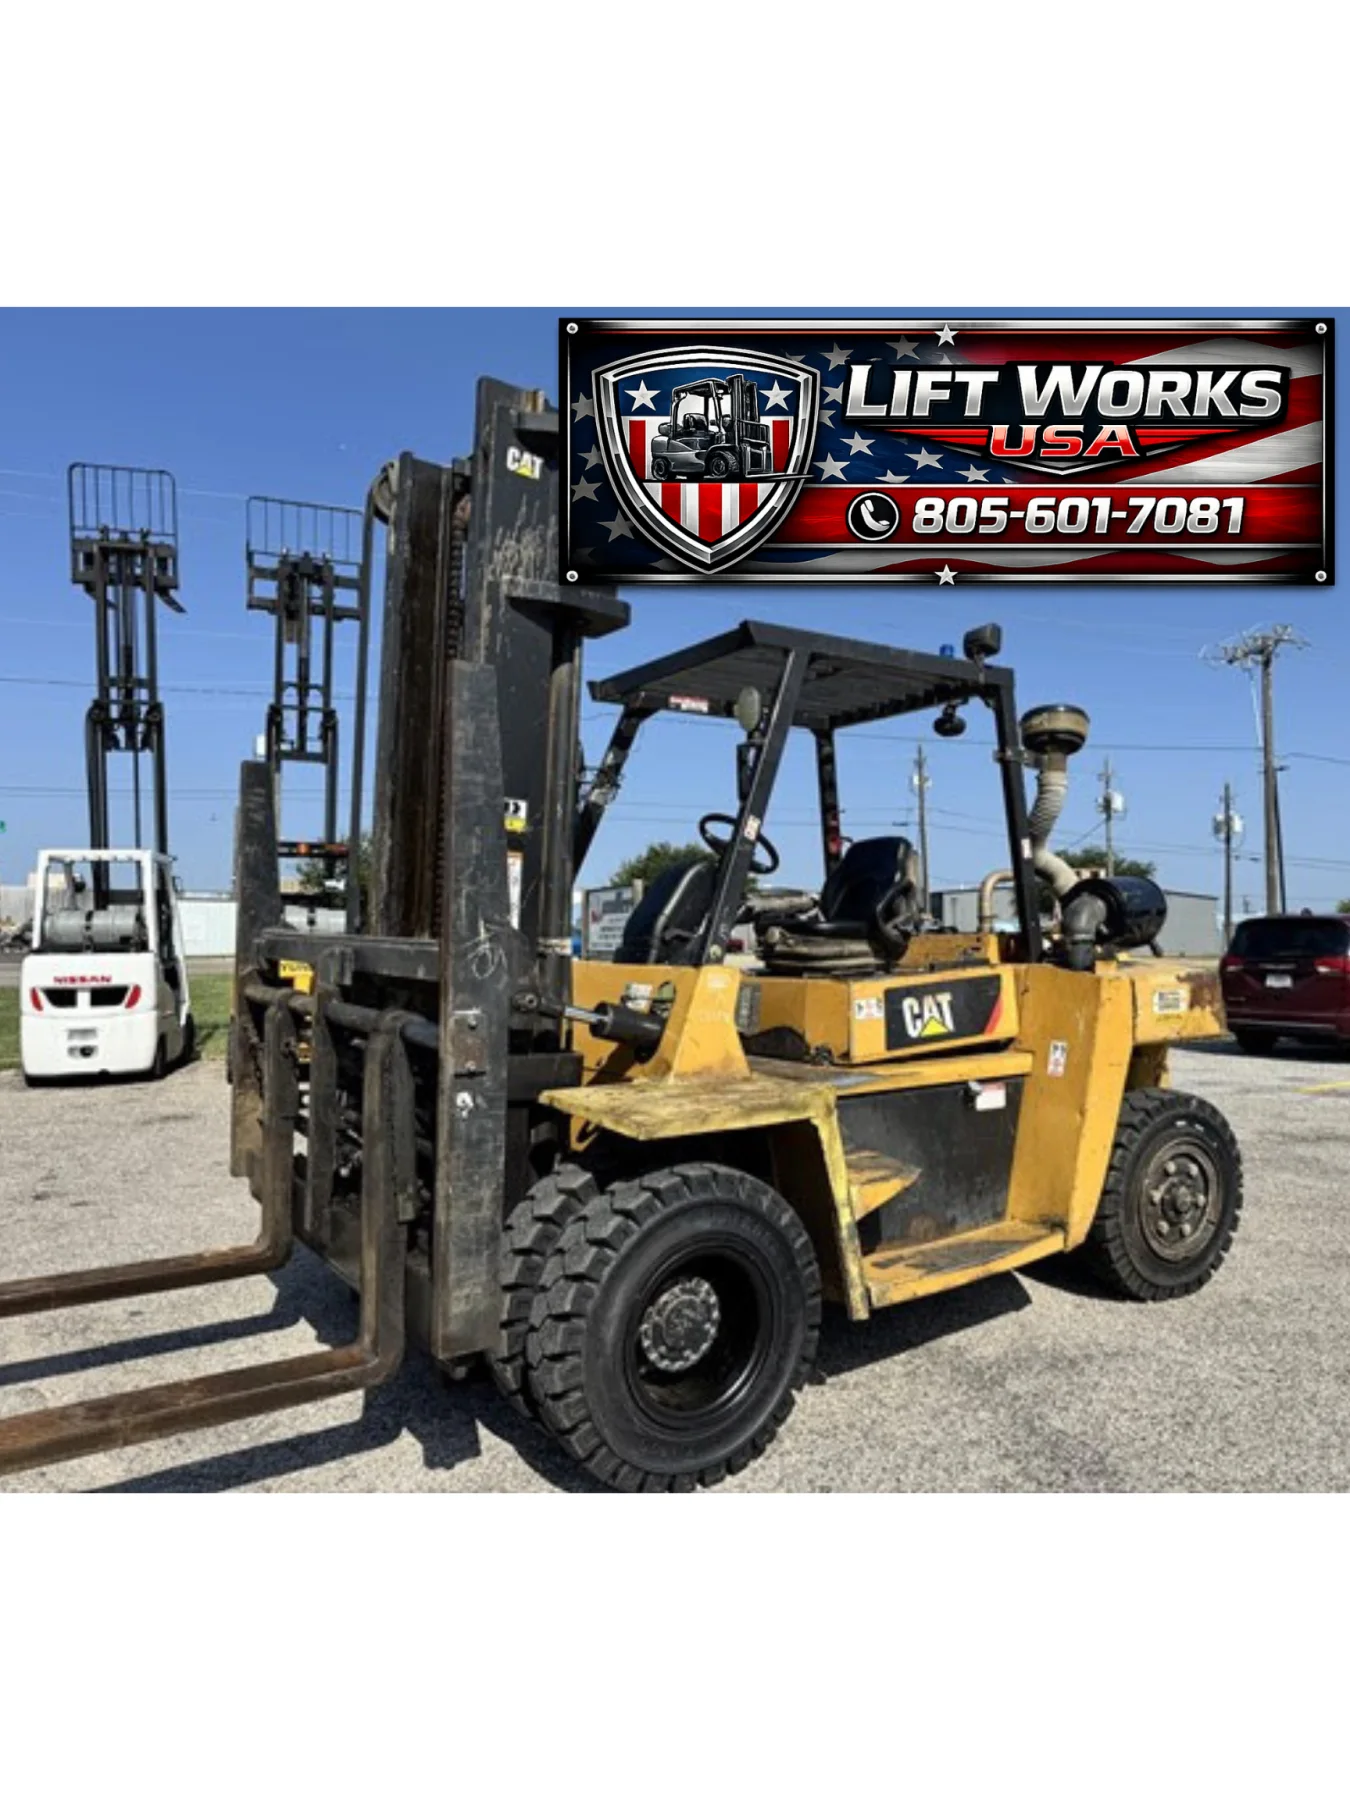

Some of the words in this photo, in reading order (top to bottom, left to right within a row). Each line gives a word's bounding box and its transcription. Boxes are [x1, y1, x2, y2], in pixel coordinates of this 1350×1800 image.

[506, 446, 545, 481] CAT
[53, 974, 113, 984] NISSAN
[902, 991, 955, 1039] CAT
